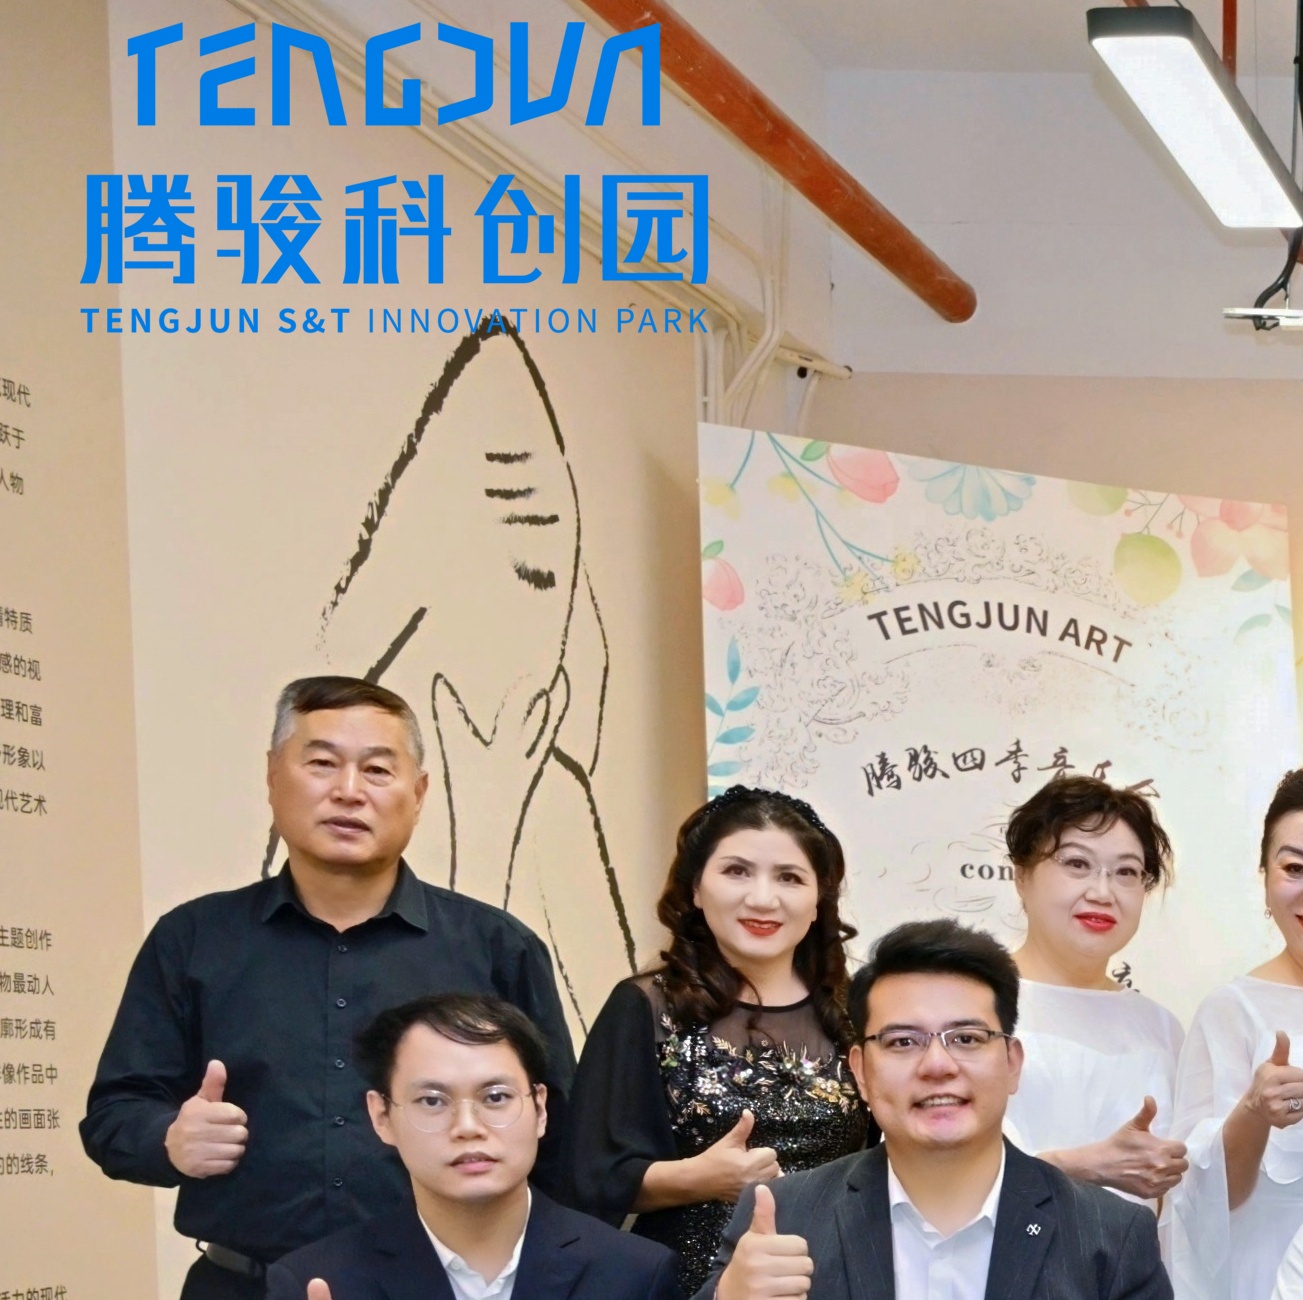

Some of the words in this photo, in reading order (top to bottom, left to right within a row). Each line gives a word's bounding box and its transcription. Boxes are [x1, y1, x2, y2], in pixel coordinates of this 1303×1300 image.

[0, 378, 30, 407] 现代
[0, 606, 33, 634] 特质
[867, 600, 1048, 641] TENGJUN
[1058, 617, 1133, 663] ART
[0, 698, 42, 726] 理和富
[0, 744, 45, 771] 形象以
[0, 788, 47, 816] 代艺术
[960, 861, 1014, 881] con
[0, 1063, 58, 1085] 像作品中
[0, 1107, 60, 1129] 的画面张
